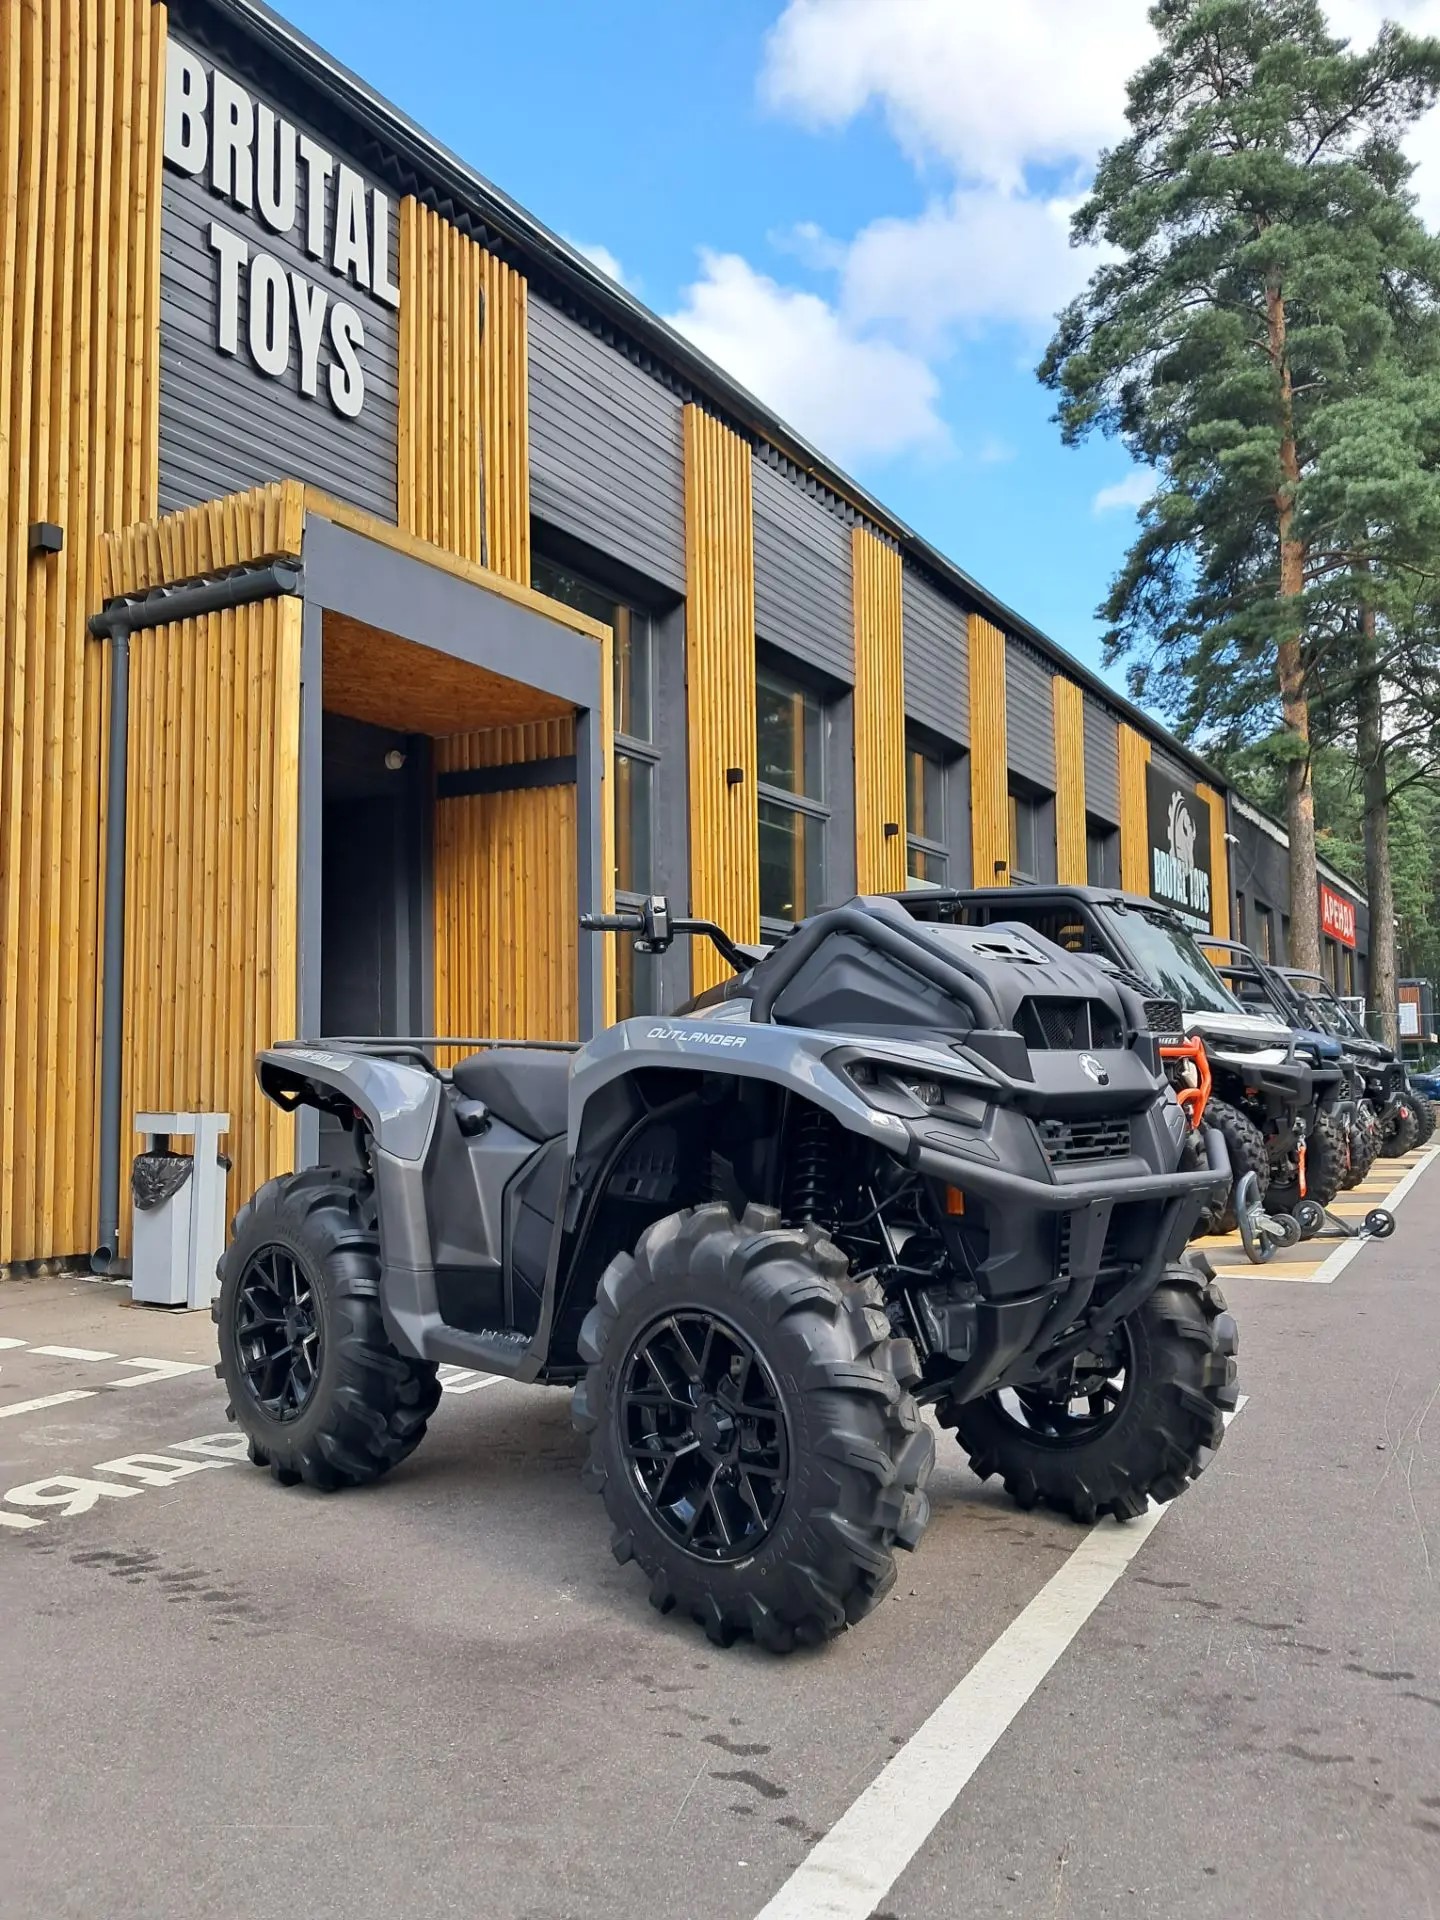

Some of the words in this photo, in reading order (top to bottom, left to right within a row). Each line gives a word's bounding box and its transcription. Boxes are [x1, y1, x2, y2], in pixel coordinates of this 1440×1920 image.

[164, 37, 400, 309] BRUTAL
[207, 221, 366, 418] TOYS
[1154, 847, 1188, 905] BRUTAL
[1325, 891, 1354, 939] АРЕНДА
[646, 1026, 747, 1049] OUTLANDER
